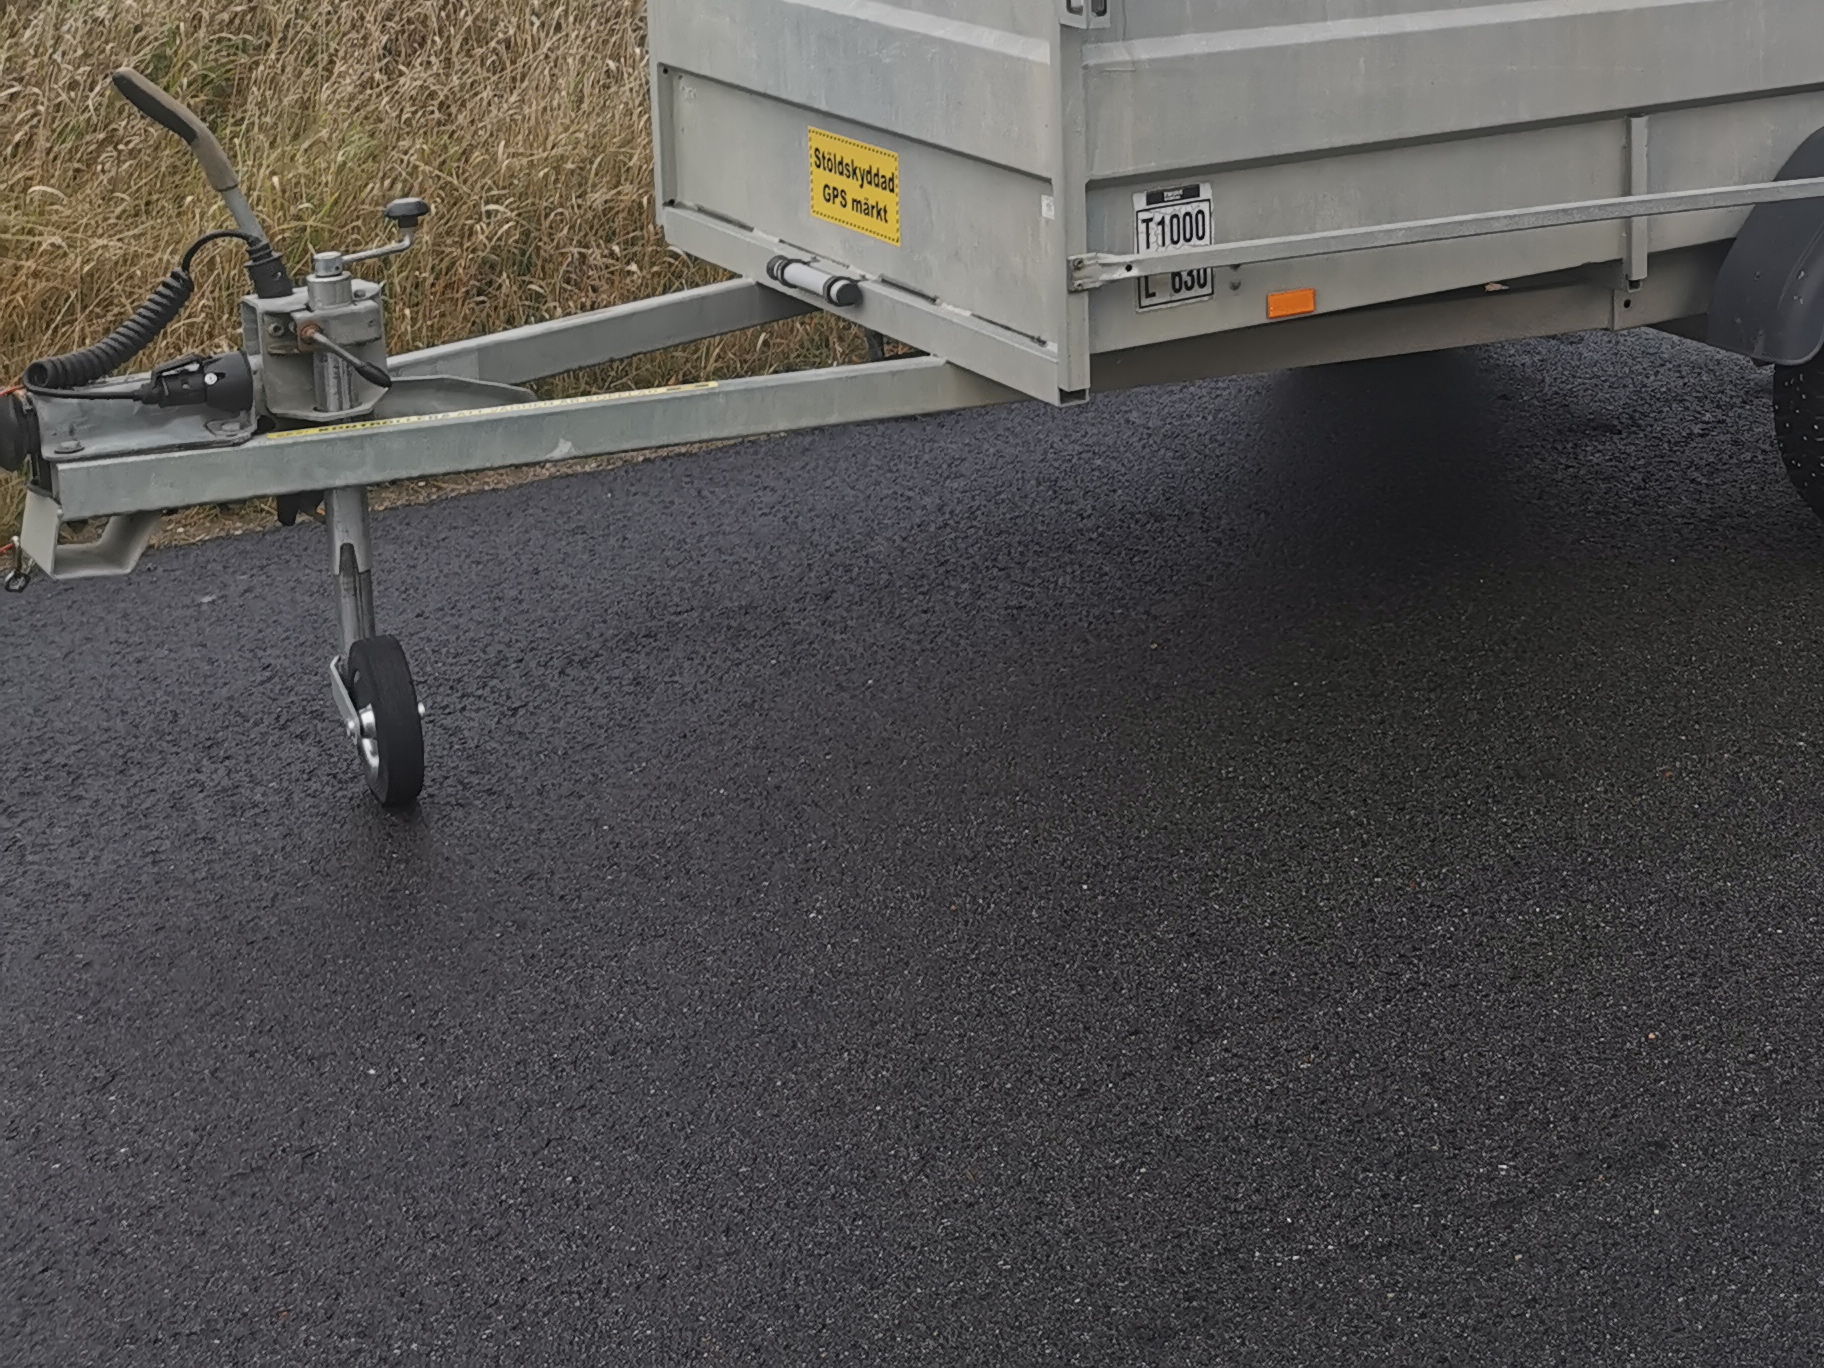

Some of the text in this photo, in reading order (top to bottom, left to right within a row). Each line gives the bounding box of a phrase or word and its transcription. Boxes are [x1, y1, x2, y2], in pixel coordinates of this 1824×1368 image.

[813, 146, 896, 194] Stöldskyddad
[822, 183, 889, 224] GPS märkt
[1141, 209, 1206, 250] T1000
